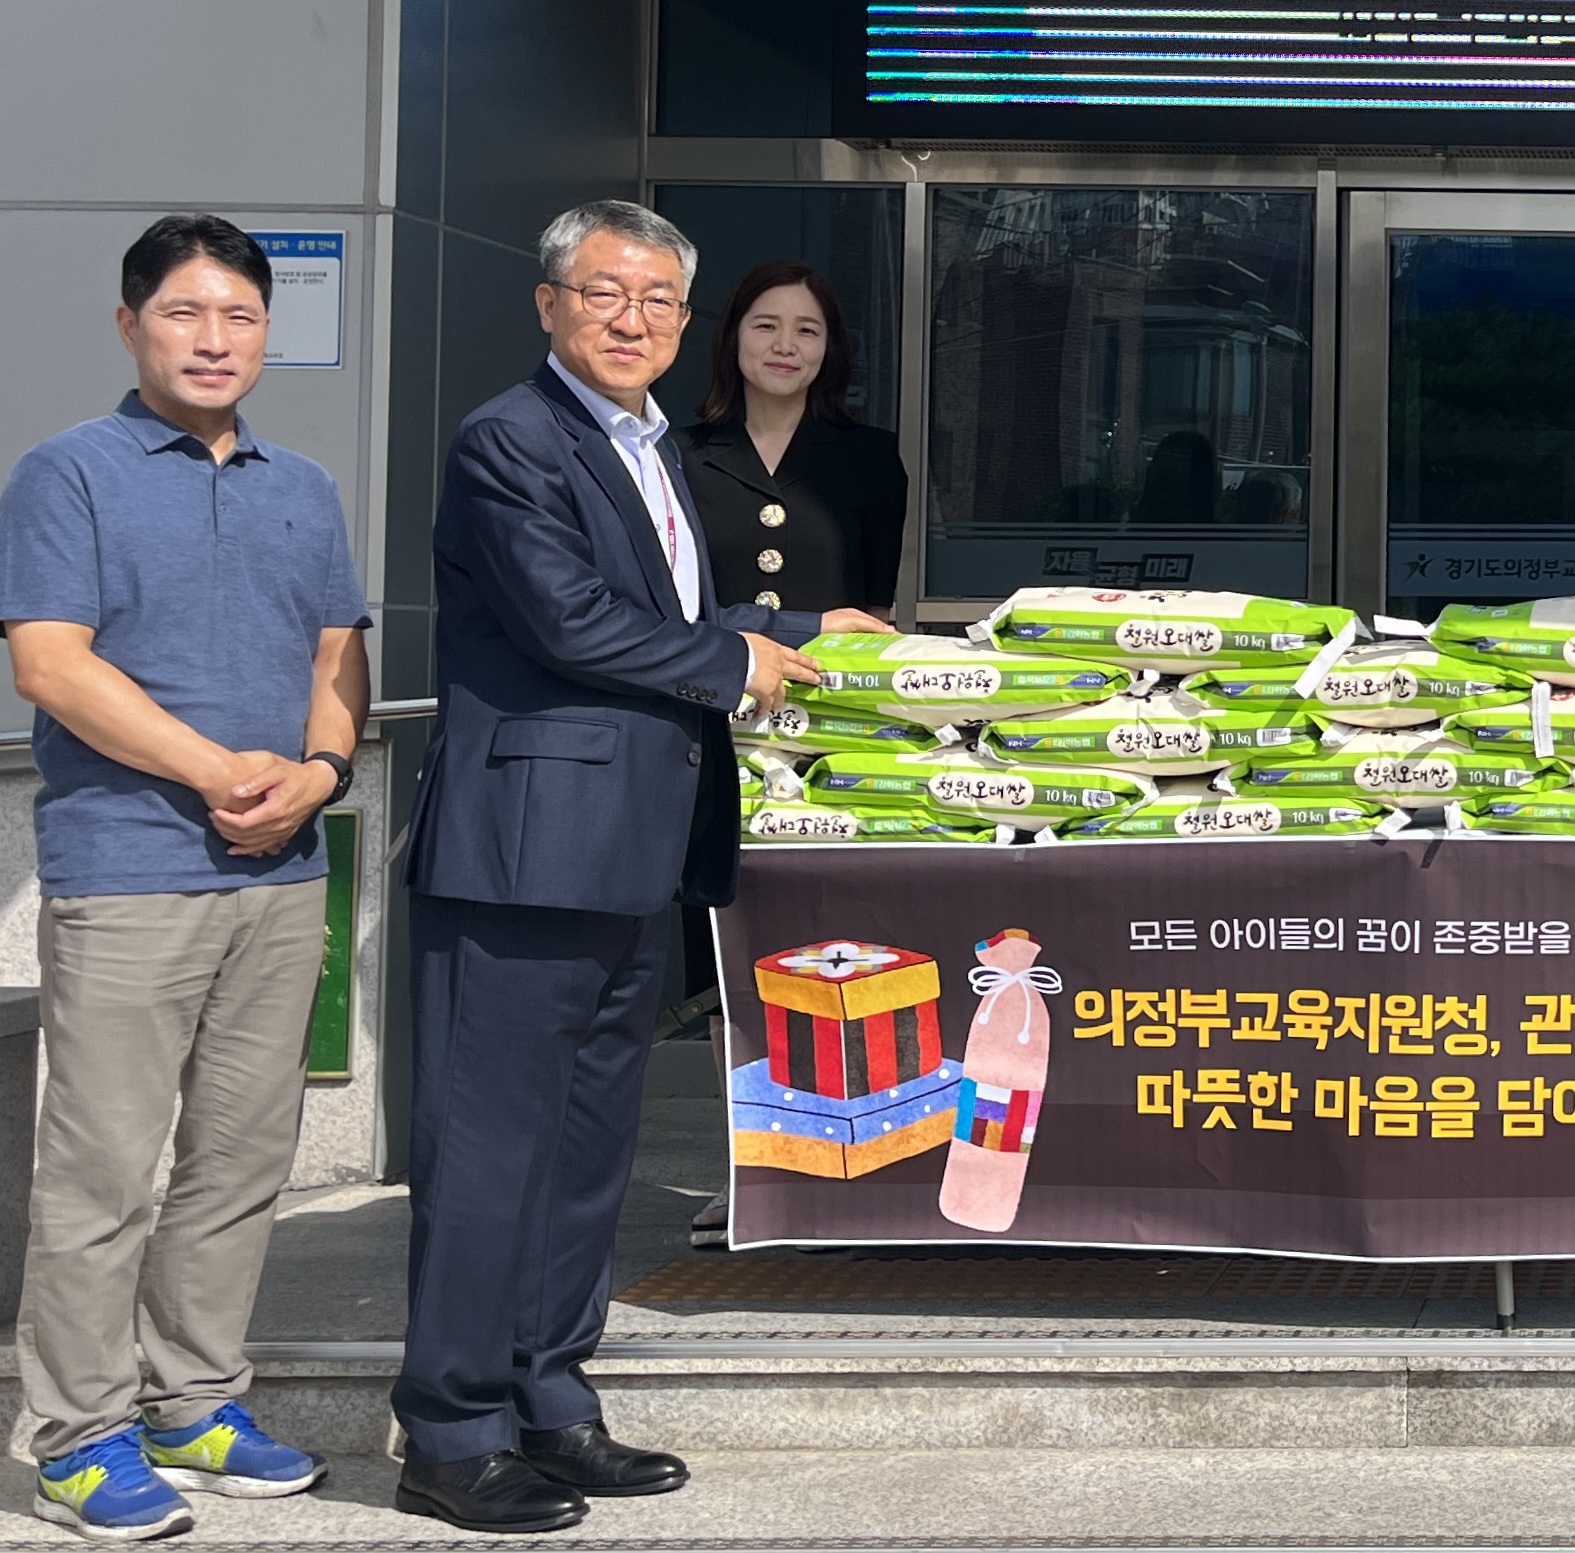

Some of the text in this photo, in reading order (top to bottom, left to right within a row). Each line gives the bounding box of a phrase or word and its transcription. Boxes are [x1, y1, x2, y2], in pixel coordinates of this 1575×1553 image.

[1145, 557, 1190, 579] 미래
[1125, 625, 1213, 651] 철원오대쌀
[1234, 635, 1248, 646] 10
[1252, 635, 1265, 648] kg
[848, 673, 862, 687] kg
[866, 675, 878, 686] 10
[902, 671, 991, 692] 철원오대쌀
[1325, 675, 1459, 700] 철원오대쌀 10 kg
[1116, 729, 1202, 753] 철원오대쌀
[1220, 733, 1234, 744] 10
[1237, 733, 1251, 746] kg
[1364, 763, 1448, 788] 철원오대쌀
[1469, 771, 1482, 782] 10
[1486, 771, 1499, 785] kg
[937, 777, 1025, 805] 철원오대쌀
[1046, 790, 1059, 801] 10
[1063, 790, 1076, 804] kg
[759, 814, 848, 838] 철원오대쌀
[1184, 810, 1272, 834] 철원오대쌀
[1293, 811, 1306, 823] 10
[1310, 811, 1323, 823] kg
[1130, 920, 1197, 950] 모든
[1211, 918, 1343, 950] 아이들의
[1357, 919, 1419, 953] 꿈이
[1434, 921, 1571, 954] 존중받을
[1074, 989, 1500, 1056] 의정부교육지원청,
[1138, 1070, 1298, 1130] 따뜻한
[1315, 1076, 1480, 1137] 마음을
